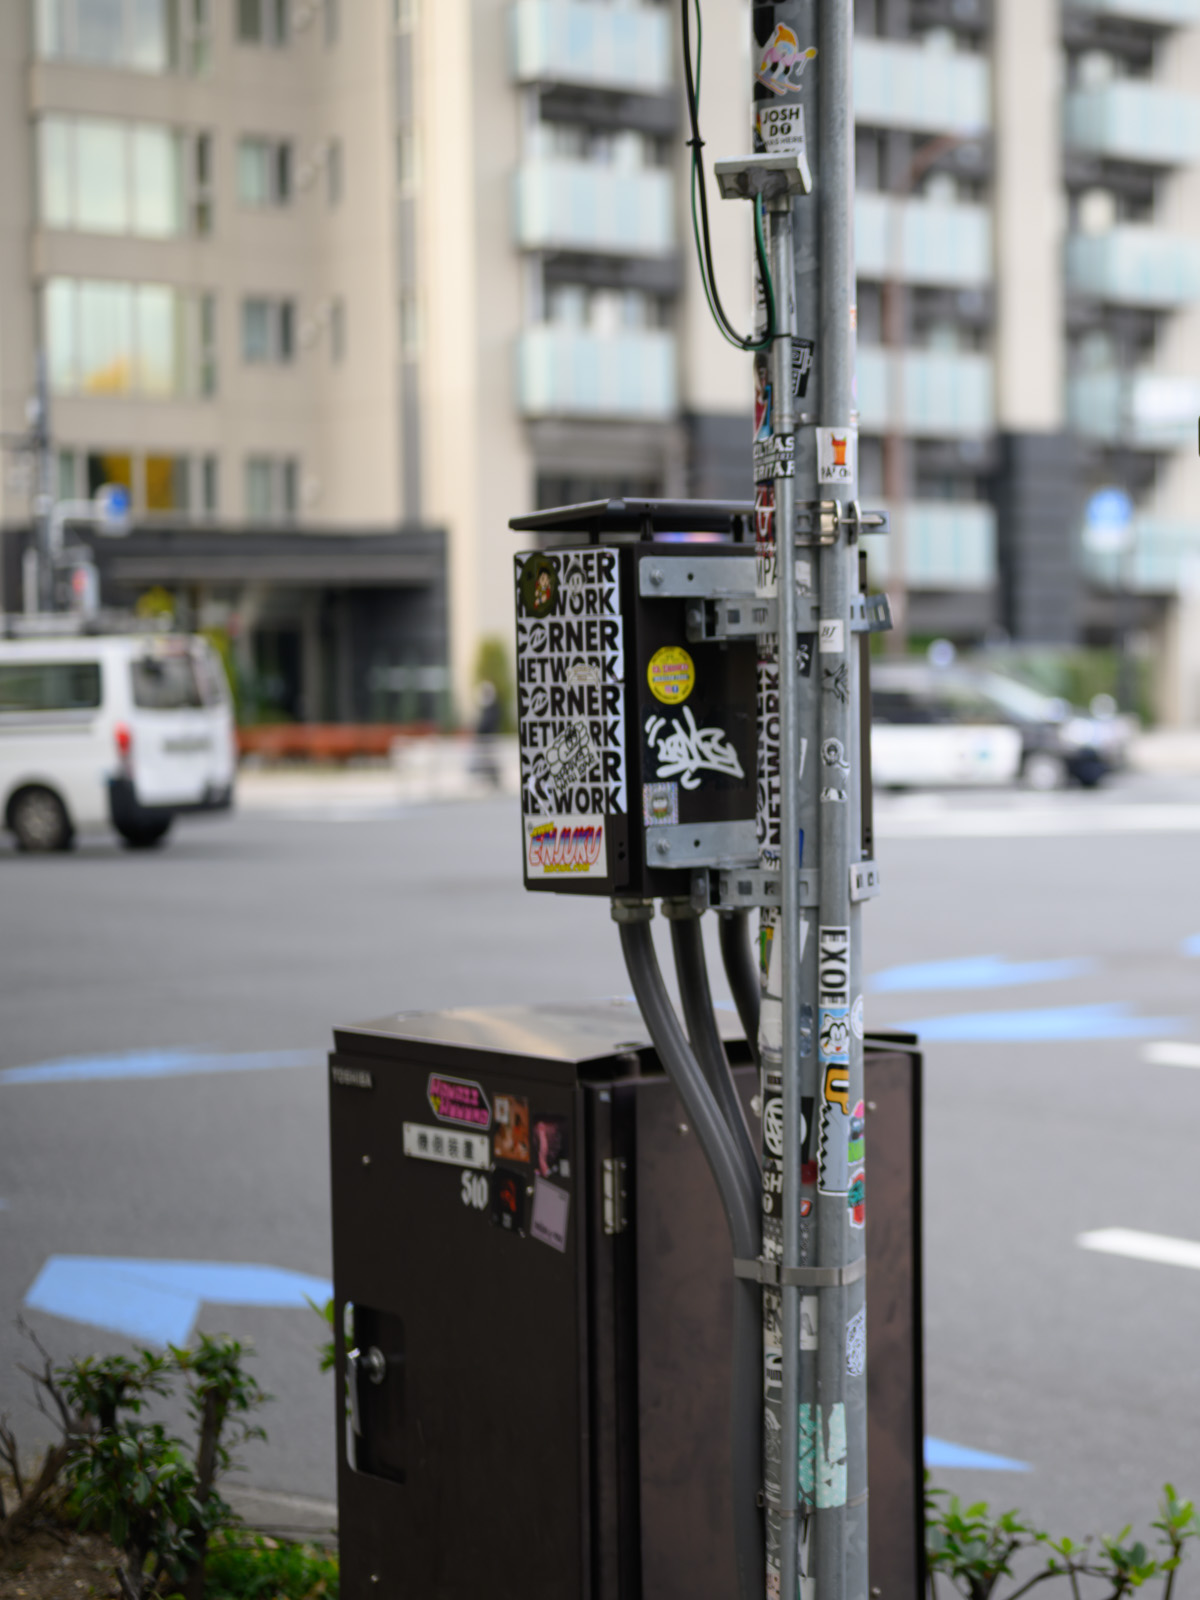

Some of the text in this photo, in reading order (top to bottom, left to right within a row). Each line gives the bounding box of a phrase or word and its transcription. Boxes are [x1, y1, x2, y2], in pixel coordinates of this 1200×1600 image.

[764, 107, 799, 124] JOSH
[521, 720, 622, 747] NETWRK
[332, 1066, 373, 1088] TOSHIBA
